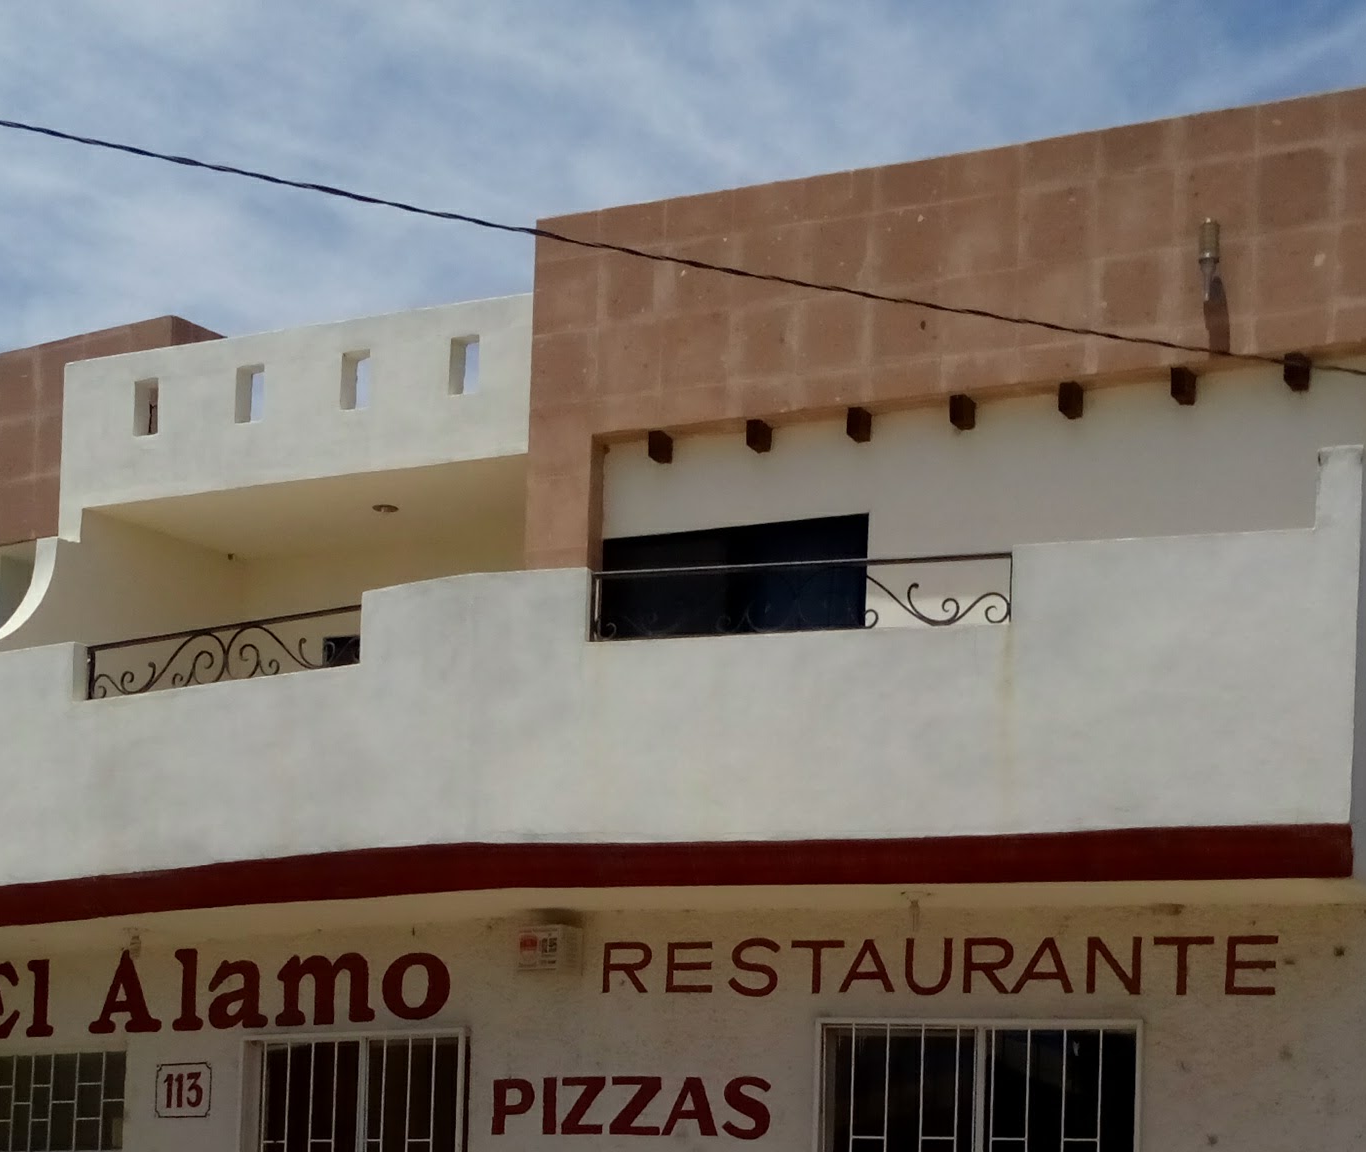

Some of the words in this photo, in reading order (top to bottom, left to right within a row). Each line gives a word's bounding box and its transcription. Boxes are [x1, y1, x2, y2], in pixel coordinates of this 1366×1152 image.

[88, 947, 452, 1035] Alamo
[601, 934, 1280, 998] RESTAURANTE
[163, 1071, 204, 1109] 113
[490, 1075, 772, 1141] PIZZAS
